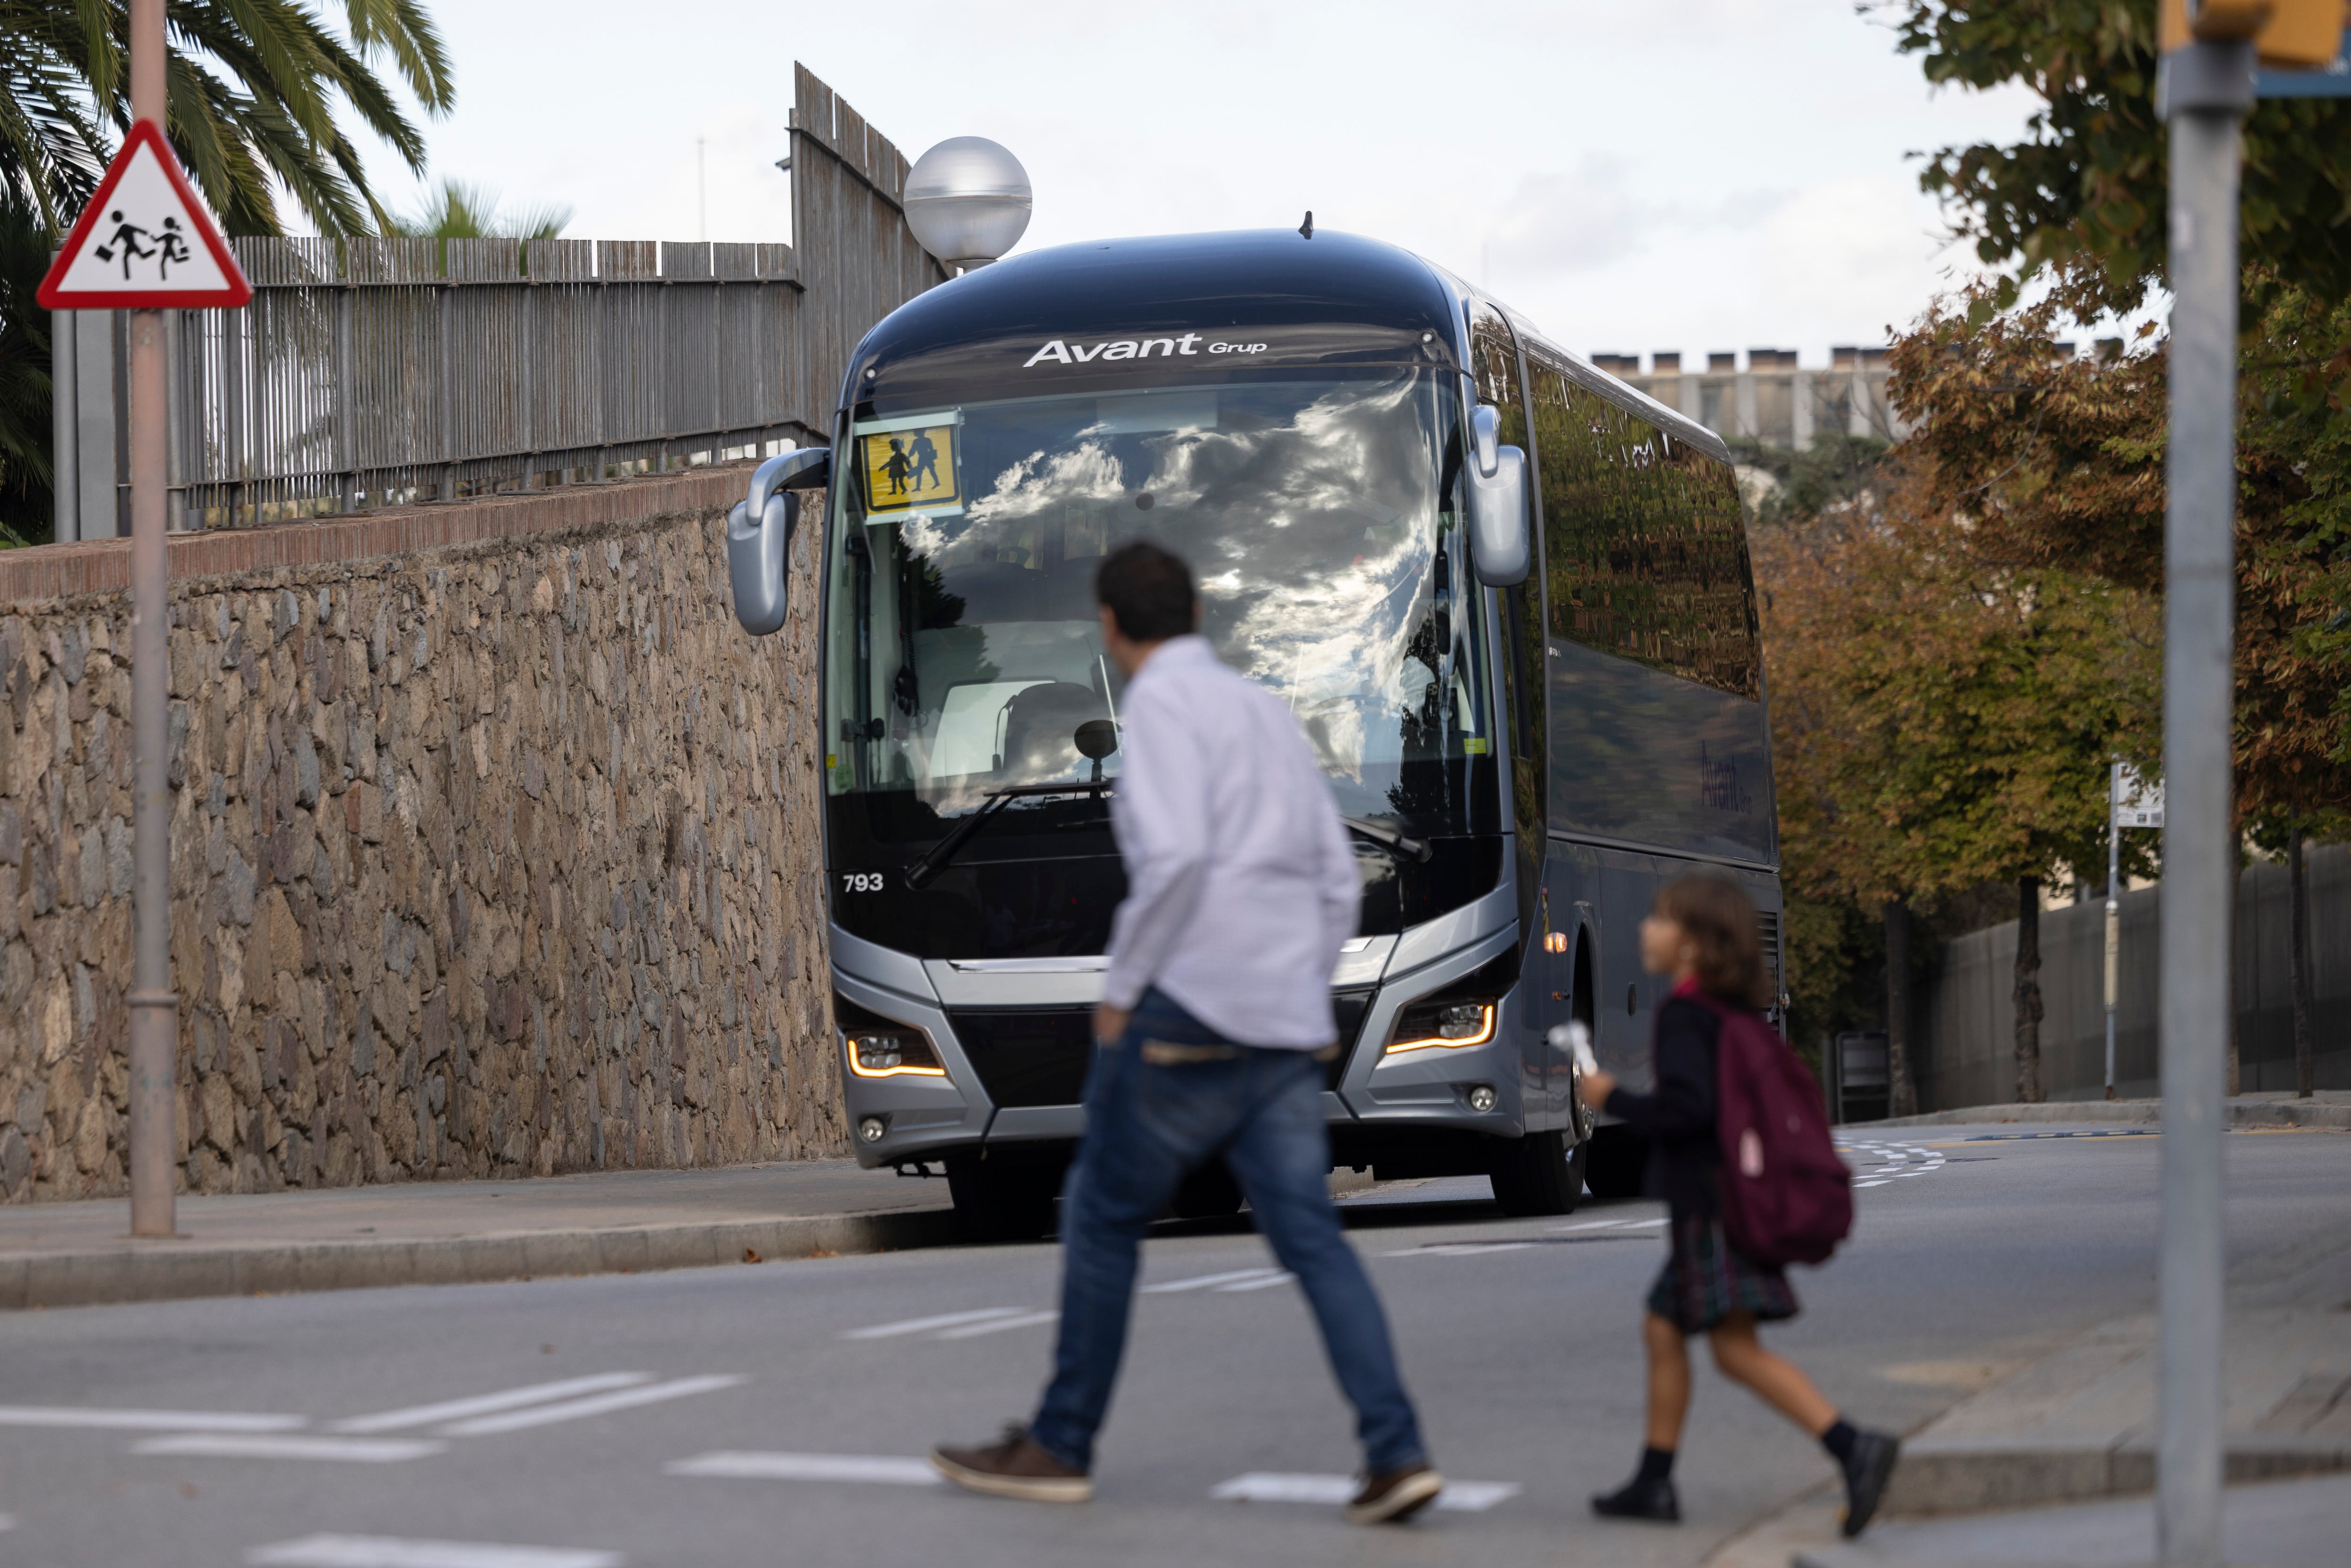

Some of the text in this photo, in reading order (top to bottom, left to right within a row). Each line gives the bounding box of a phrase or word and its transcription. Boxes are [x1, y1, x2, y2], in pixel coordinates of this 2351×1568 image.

[1022, 332, 1268, 368] Avant Grup
[1702, 740, 1752, 816] Avant Grup
[843, 872, 884, 893] 793
